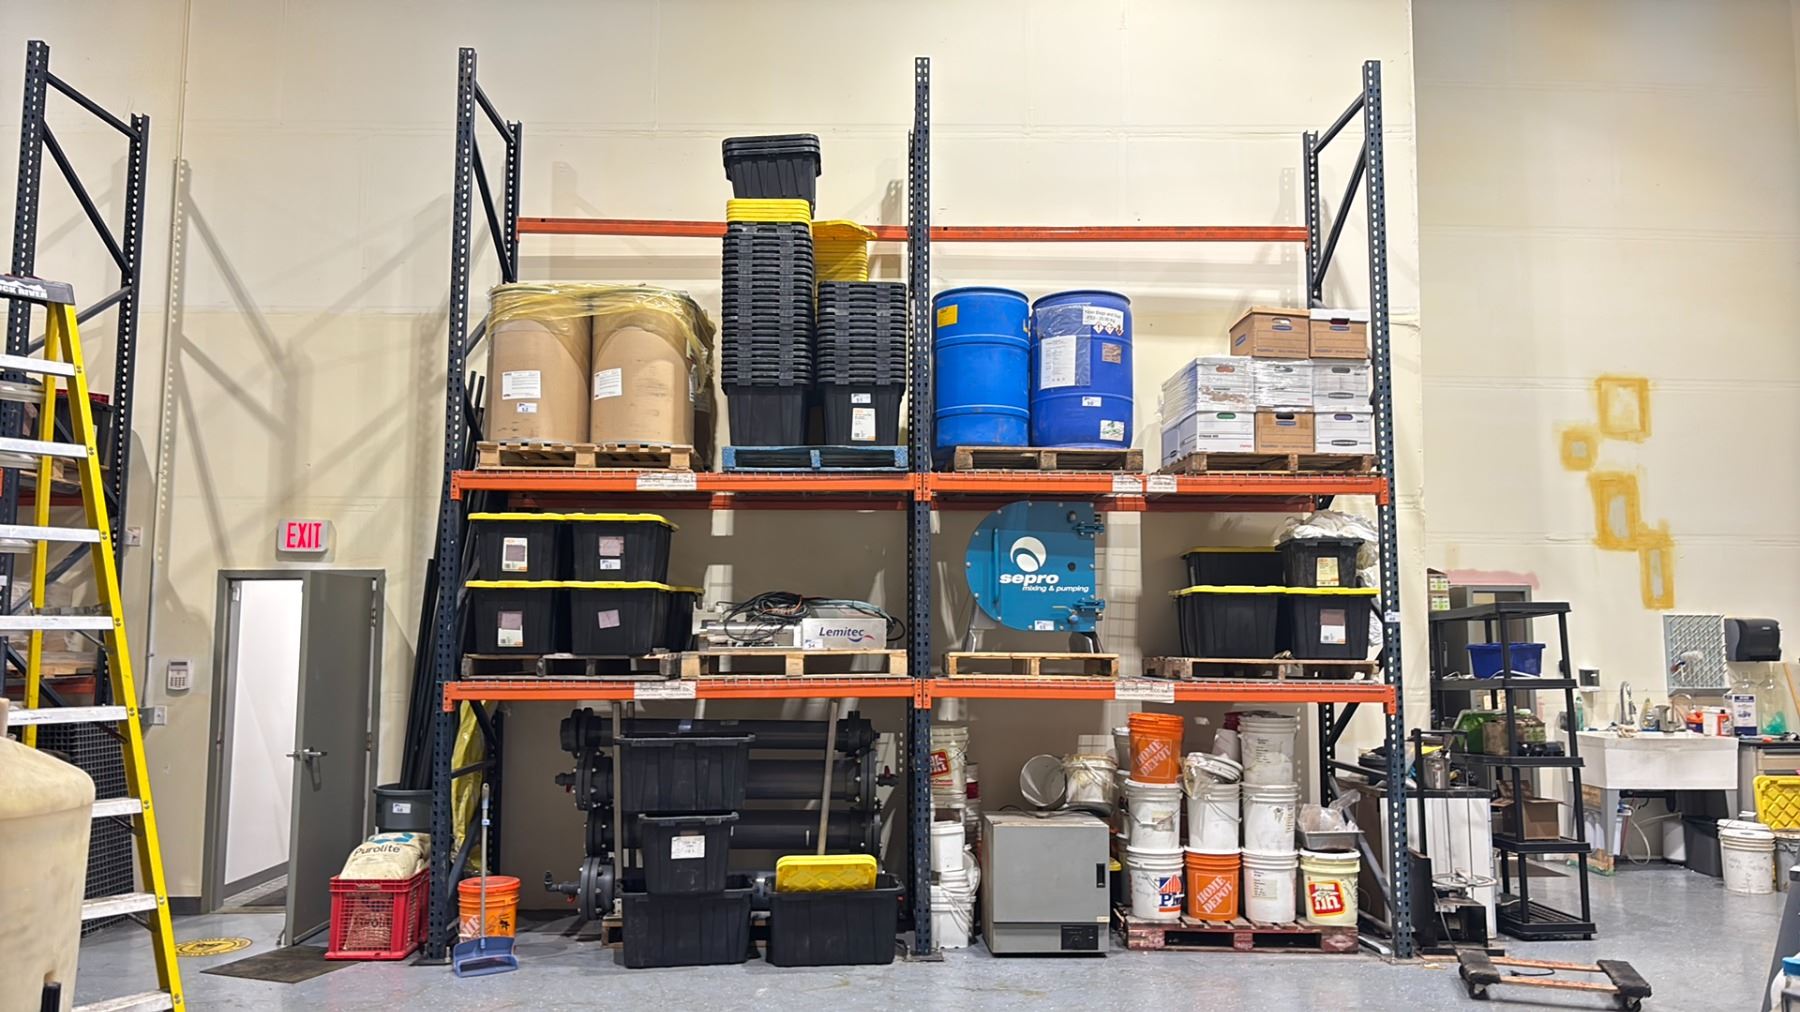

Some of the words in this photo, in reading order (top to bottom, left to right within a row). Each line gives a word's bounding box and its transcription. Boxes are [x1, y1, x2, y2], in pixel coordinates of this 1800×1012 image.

[287, 523, 322, 548] EXIT
[1000, 573, 1060, 587] sepro
[1022, 585, 1047, 593] mixing
[1056, 585, 1089, 593] pumping
[818, 626, 865, 637] Lemitec
[1136, 740, 1163, 767] HOME
[1140, 745, 1171, 776] DEPOT
[353, 844, 401, 857] Purolite
[1197, 876, 1227, 904] HOME
[1202, 880, 1233, 913] DEPOT
